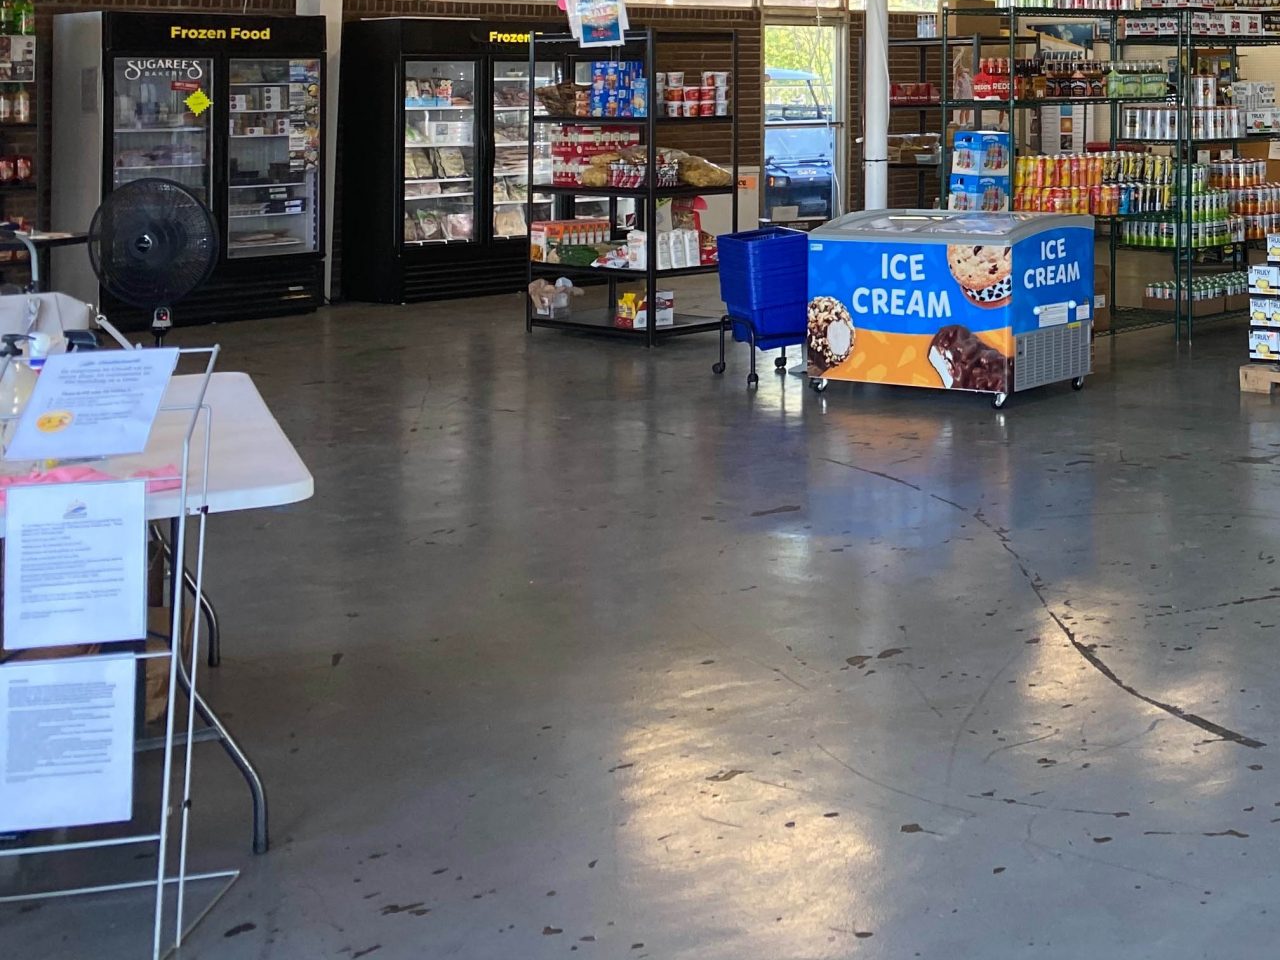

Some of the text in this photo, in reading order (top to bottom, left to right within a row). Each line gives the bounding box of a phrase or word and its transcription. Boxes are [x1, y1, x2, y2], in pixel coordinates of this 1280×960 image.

[171, 26, 271, 40] Frozen Food
[489, 31, 531, 43] Frozen
[124, 59, 203, 80] SUGAREE'S
[1040, 237, 1067, 261] ICE
[881, 253, 926, 281] ICE
[1023, 261, 1081, 289] CREAM
[852, 287, 951, 318] CREAM
